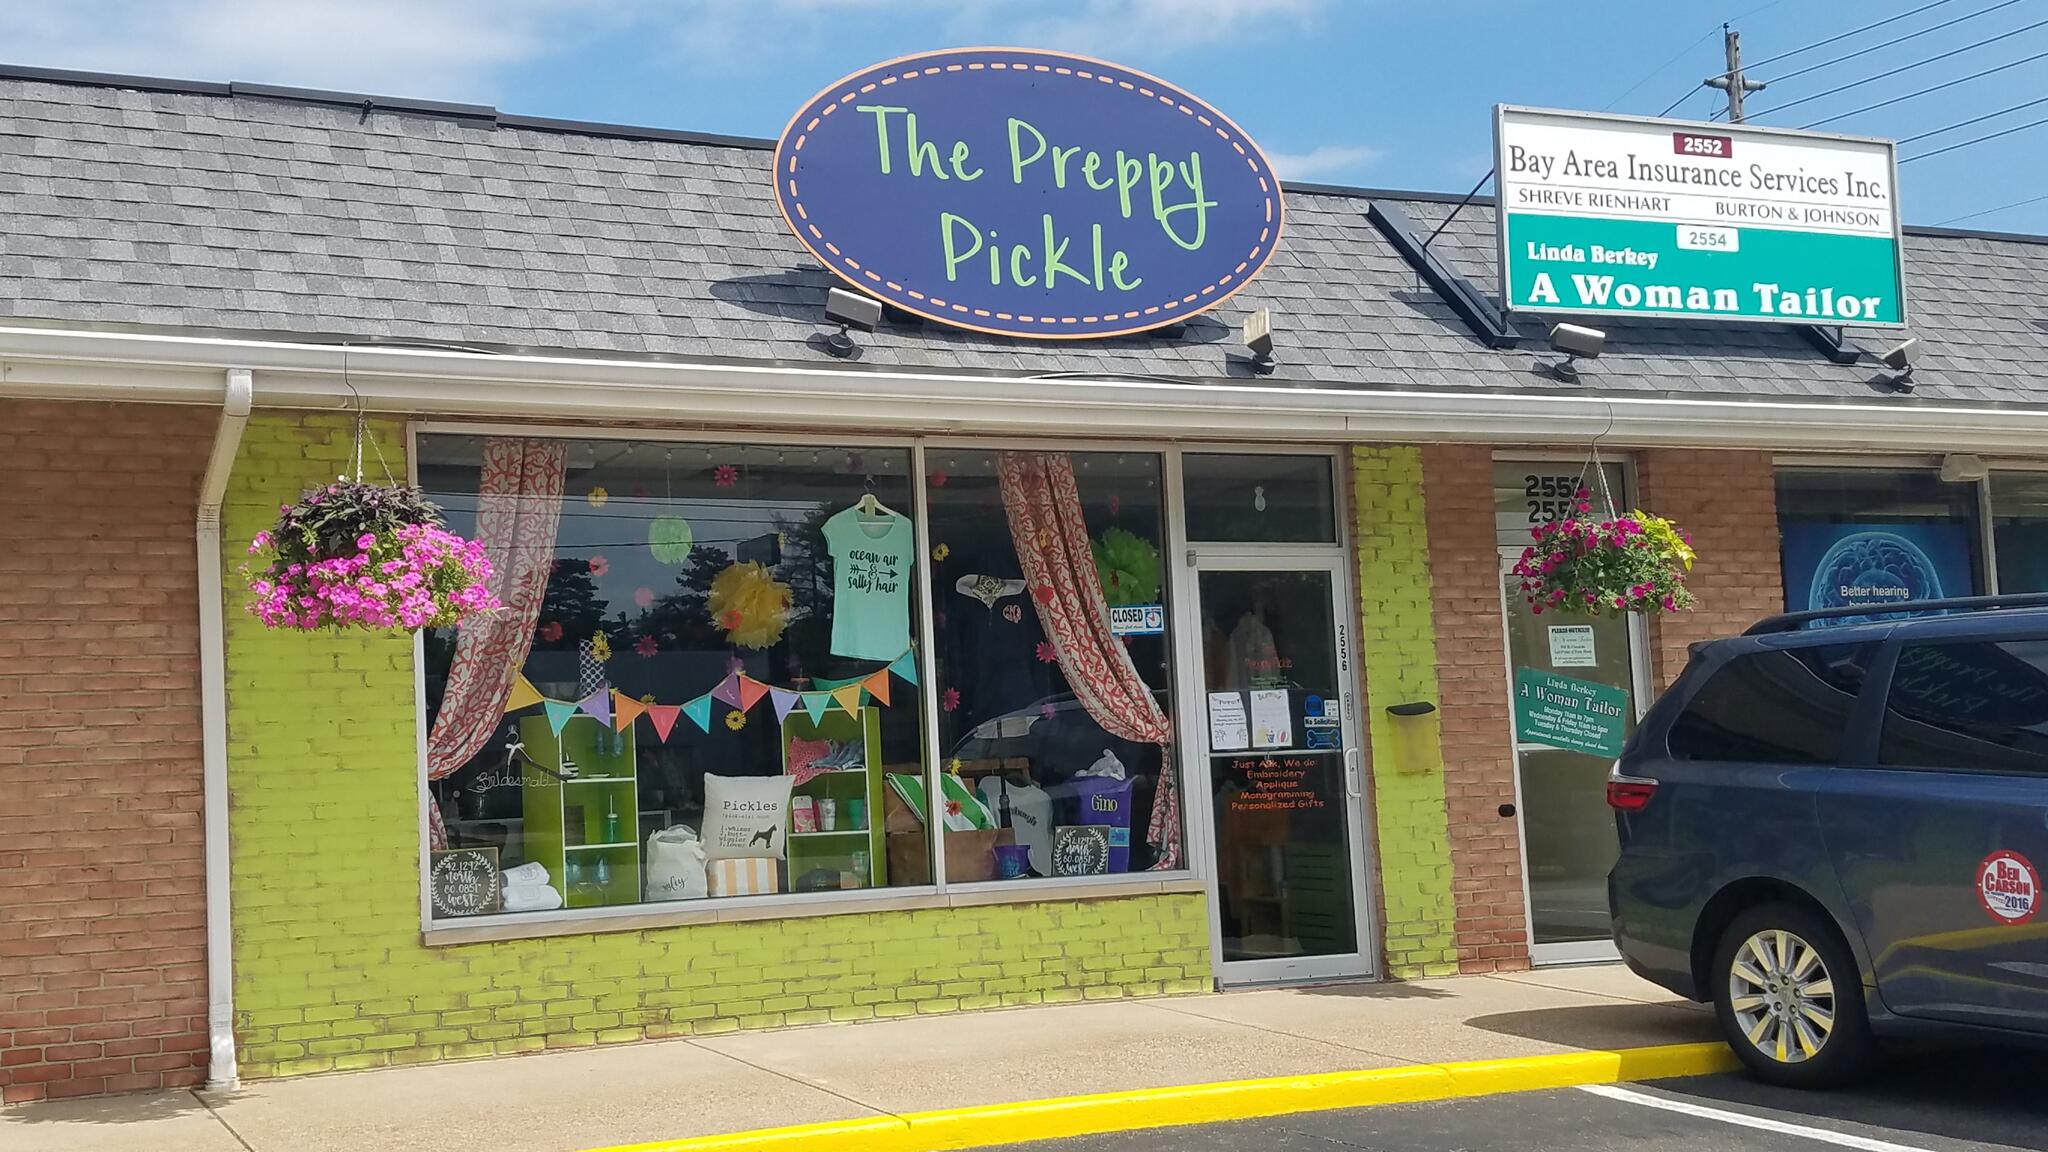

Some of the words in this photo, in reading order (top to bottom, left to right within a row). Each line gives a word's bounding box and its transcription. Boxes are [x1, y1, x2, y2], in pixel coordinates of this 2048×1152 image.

[1684, 137, 1723, 155] 2552
[857, 105, 983, 181] The
[1008, 118, 1217, 250] Preppy
[1509, 145, 1555, 181] Bay
[1564, 149, 1619, 179] Area
[1627, 154, 1742, 188] Insurance
[1750, 165, 1838, 196] Services
[1845, 172, 1886, 199] Inc.
[1519, 188, 1583, 207] SHREVE
[1588, 193, 1671, 211] RIENHART
[1716, 202, 1783, 220] BURTON
[1788, 207, 1799, 221] &
[1804, 208, 1880, 226] JOHNSON
[1689, 231, 1727, 247] 2554
[941, 212, 1142, 291] Pickle
[1527, 241, 1585, 263] Linda
[1591, 245, 1658, 270] Berkey
[1528, 273, 1560, 302] A
[1571, 274, 1739, 311] Woman
[1753, 283, 1881, 319] Tailor
[1528, 501, 1573, 522] 255
[850, 550, 880, 564] ocean
[883, 554, 898, 566] air
[868, 564, 878, 580] &
[848, 575, 872, 593] salty
[876, 578, 898, 593] hair
[1841, 586, 1870, 596] Better
[1872, 585, 1909, 598] hearing
[1113, 609, 1143, 622] CLOSED
[1547, 678, 1567, 689] Linda
[1571, 683, 1597, 697] Berkey
[1521, 683, 1529, 697] A
[1536, 686, 1578, 708] Woman
[1585, 697, 1621, 717] Tailor
[1544, 706, 1563, 717] Monday
[1232, 760, 1255, 768] Just
[1247, 770, 1305, 779] Embroidery
[1256, 781, 1298, 789] Applique
[1091, 794, 1117, 811] Gino
[1241, 792, 1314, 800] Monogramming
[723, 801, 777, 810] Pickles
[1232, 801, 1295, 810] Personalized
[1298, 800, 1324, 808] Gifts
[2005, 896, 2029, 910] 2016
